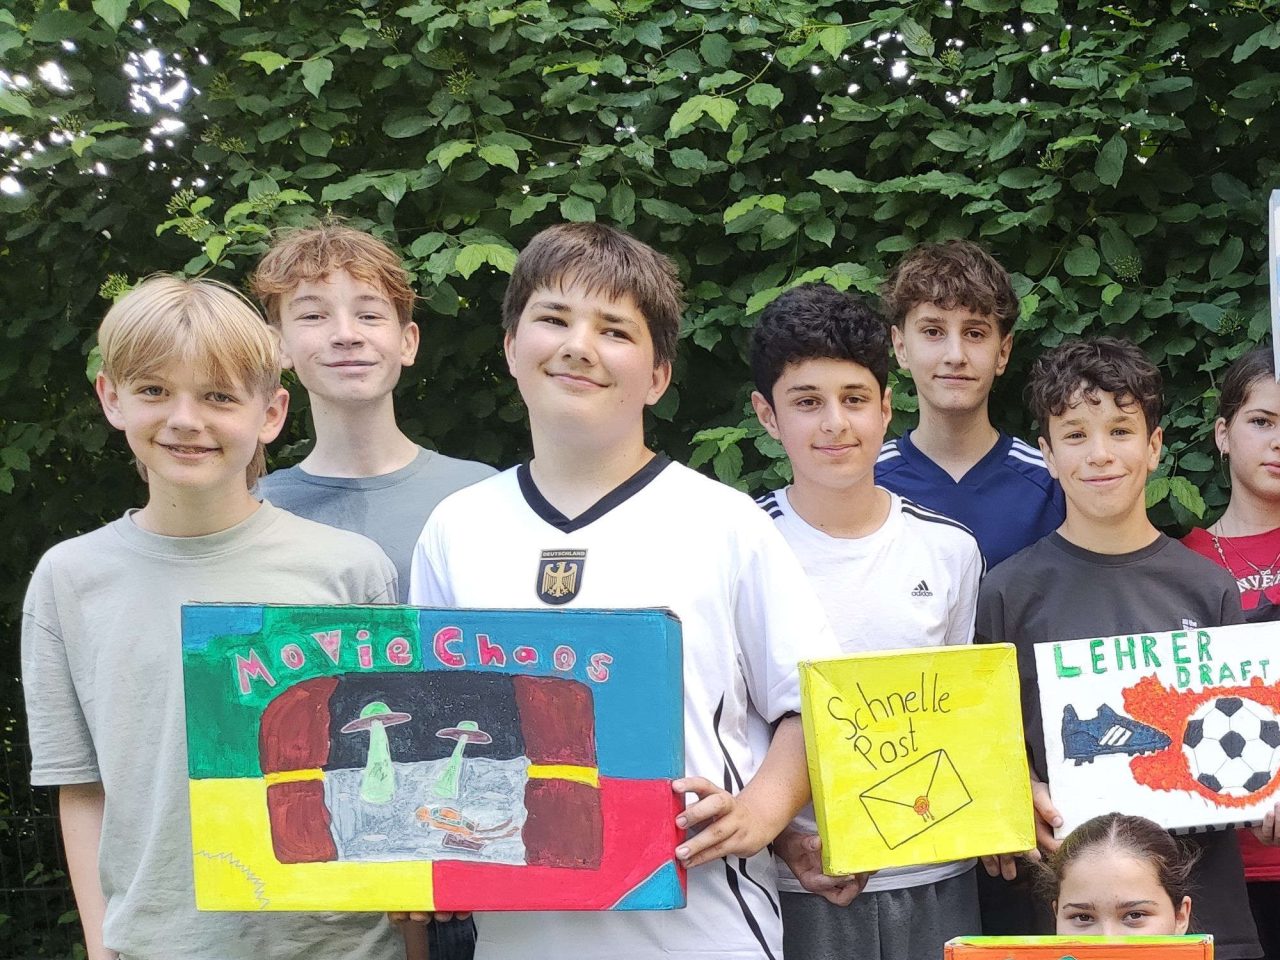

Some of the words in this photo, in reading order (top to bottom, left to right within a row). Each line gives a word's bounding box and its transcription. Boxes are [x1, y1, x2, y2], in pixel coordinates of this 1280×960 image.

[433, 627, 614, 683] Chaos
[1052, 630, 1213, 679] LEHRER
[1176, 659, 1270, 689] DRAFT
[827, 672, 951, 741] Schnelle
[853, 728, 919, 770] Post
